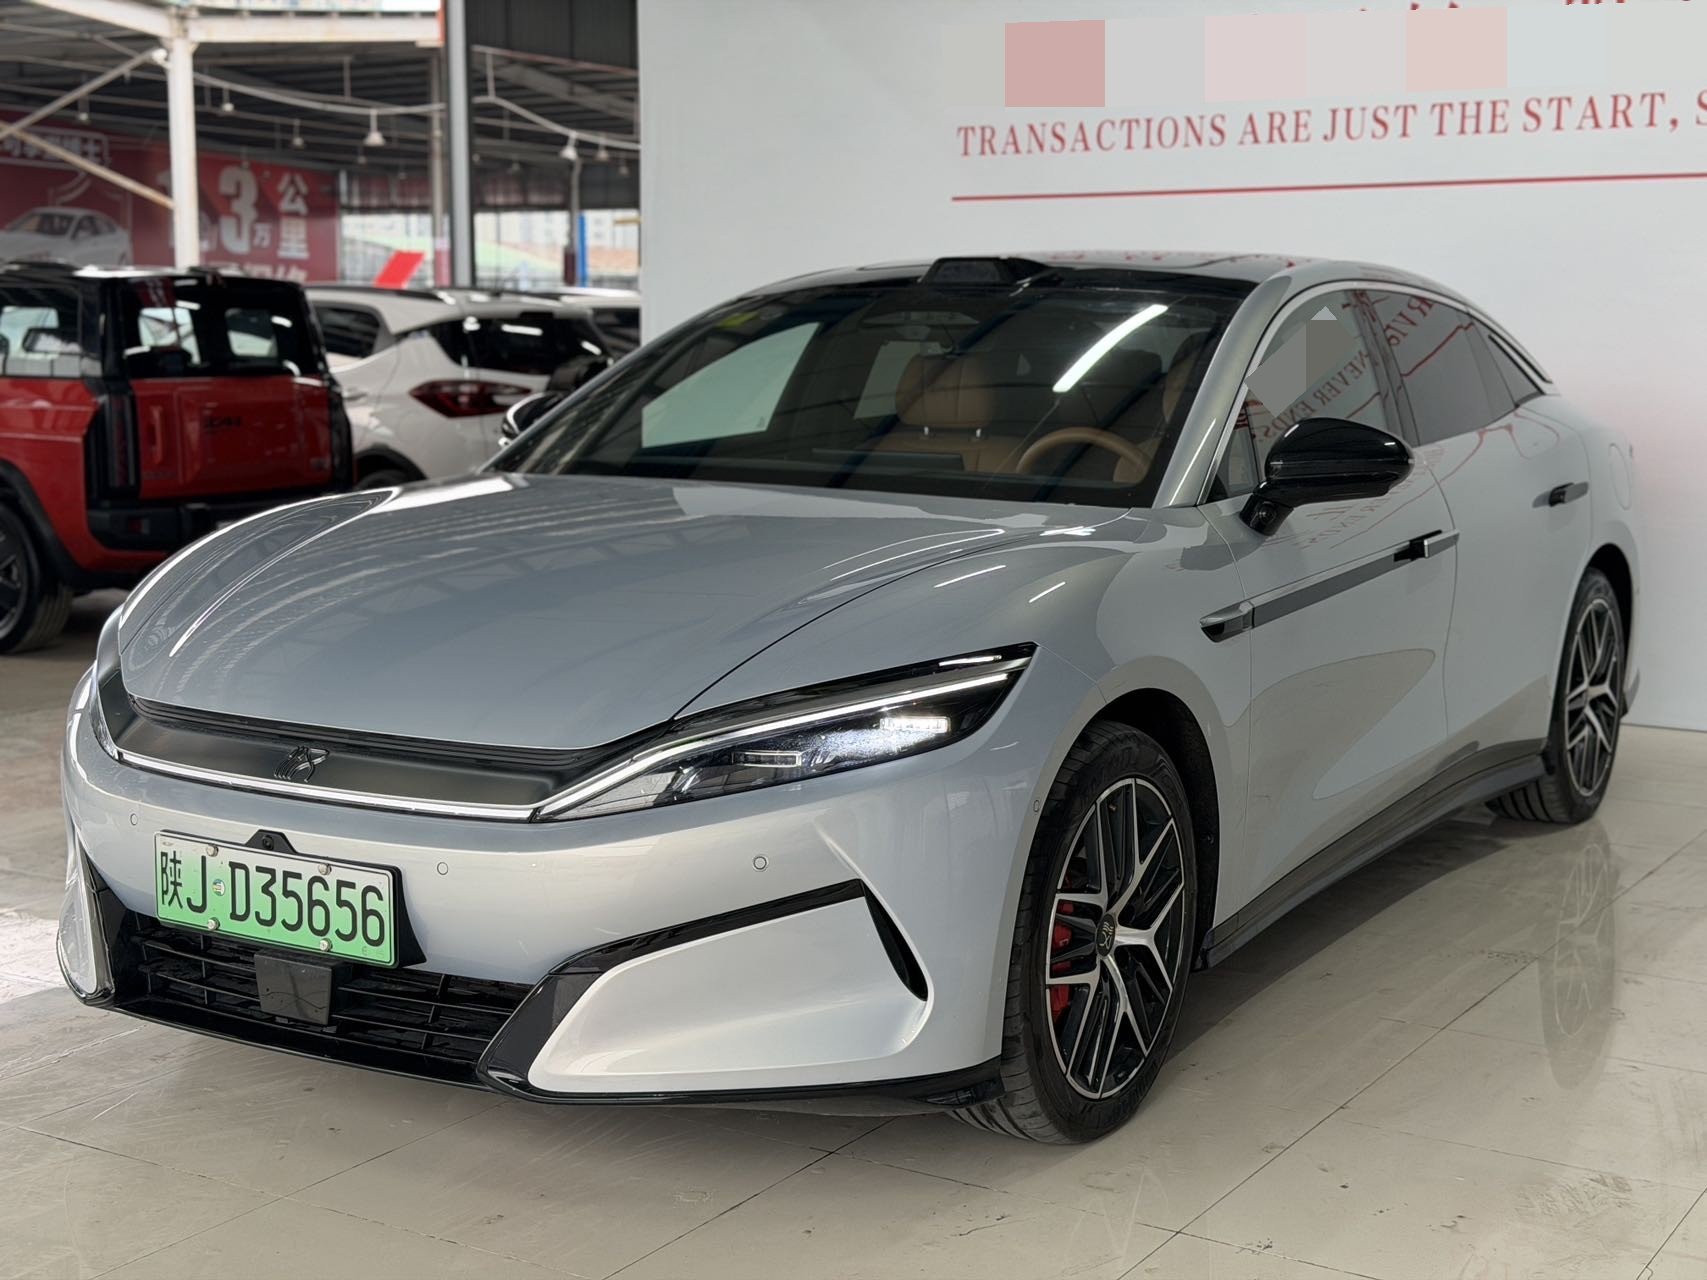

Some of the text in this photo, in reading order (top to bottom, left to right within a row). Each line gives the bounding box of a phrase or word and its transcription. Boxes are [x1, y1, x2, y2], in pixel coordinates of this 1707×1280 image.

[957, 114, 1227, 156] TRANSACTIONS
[1238, 109, 1313, 145] ARE
[1323, 104, 1418, 142] JUST
[1430, 99, 1510, 137] THE
[1523, 92, 1680, 133] START,
